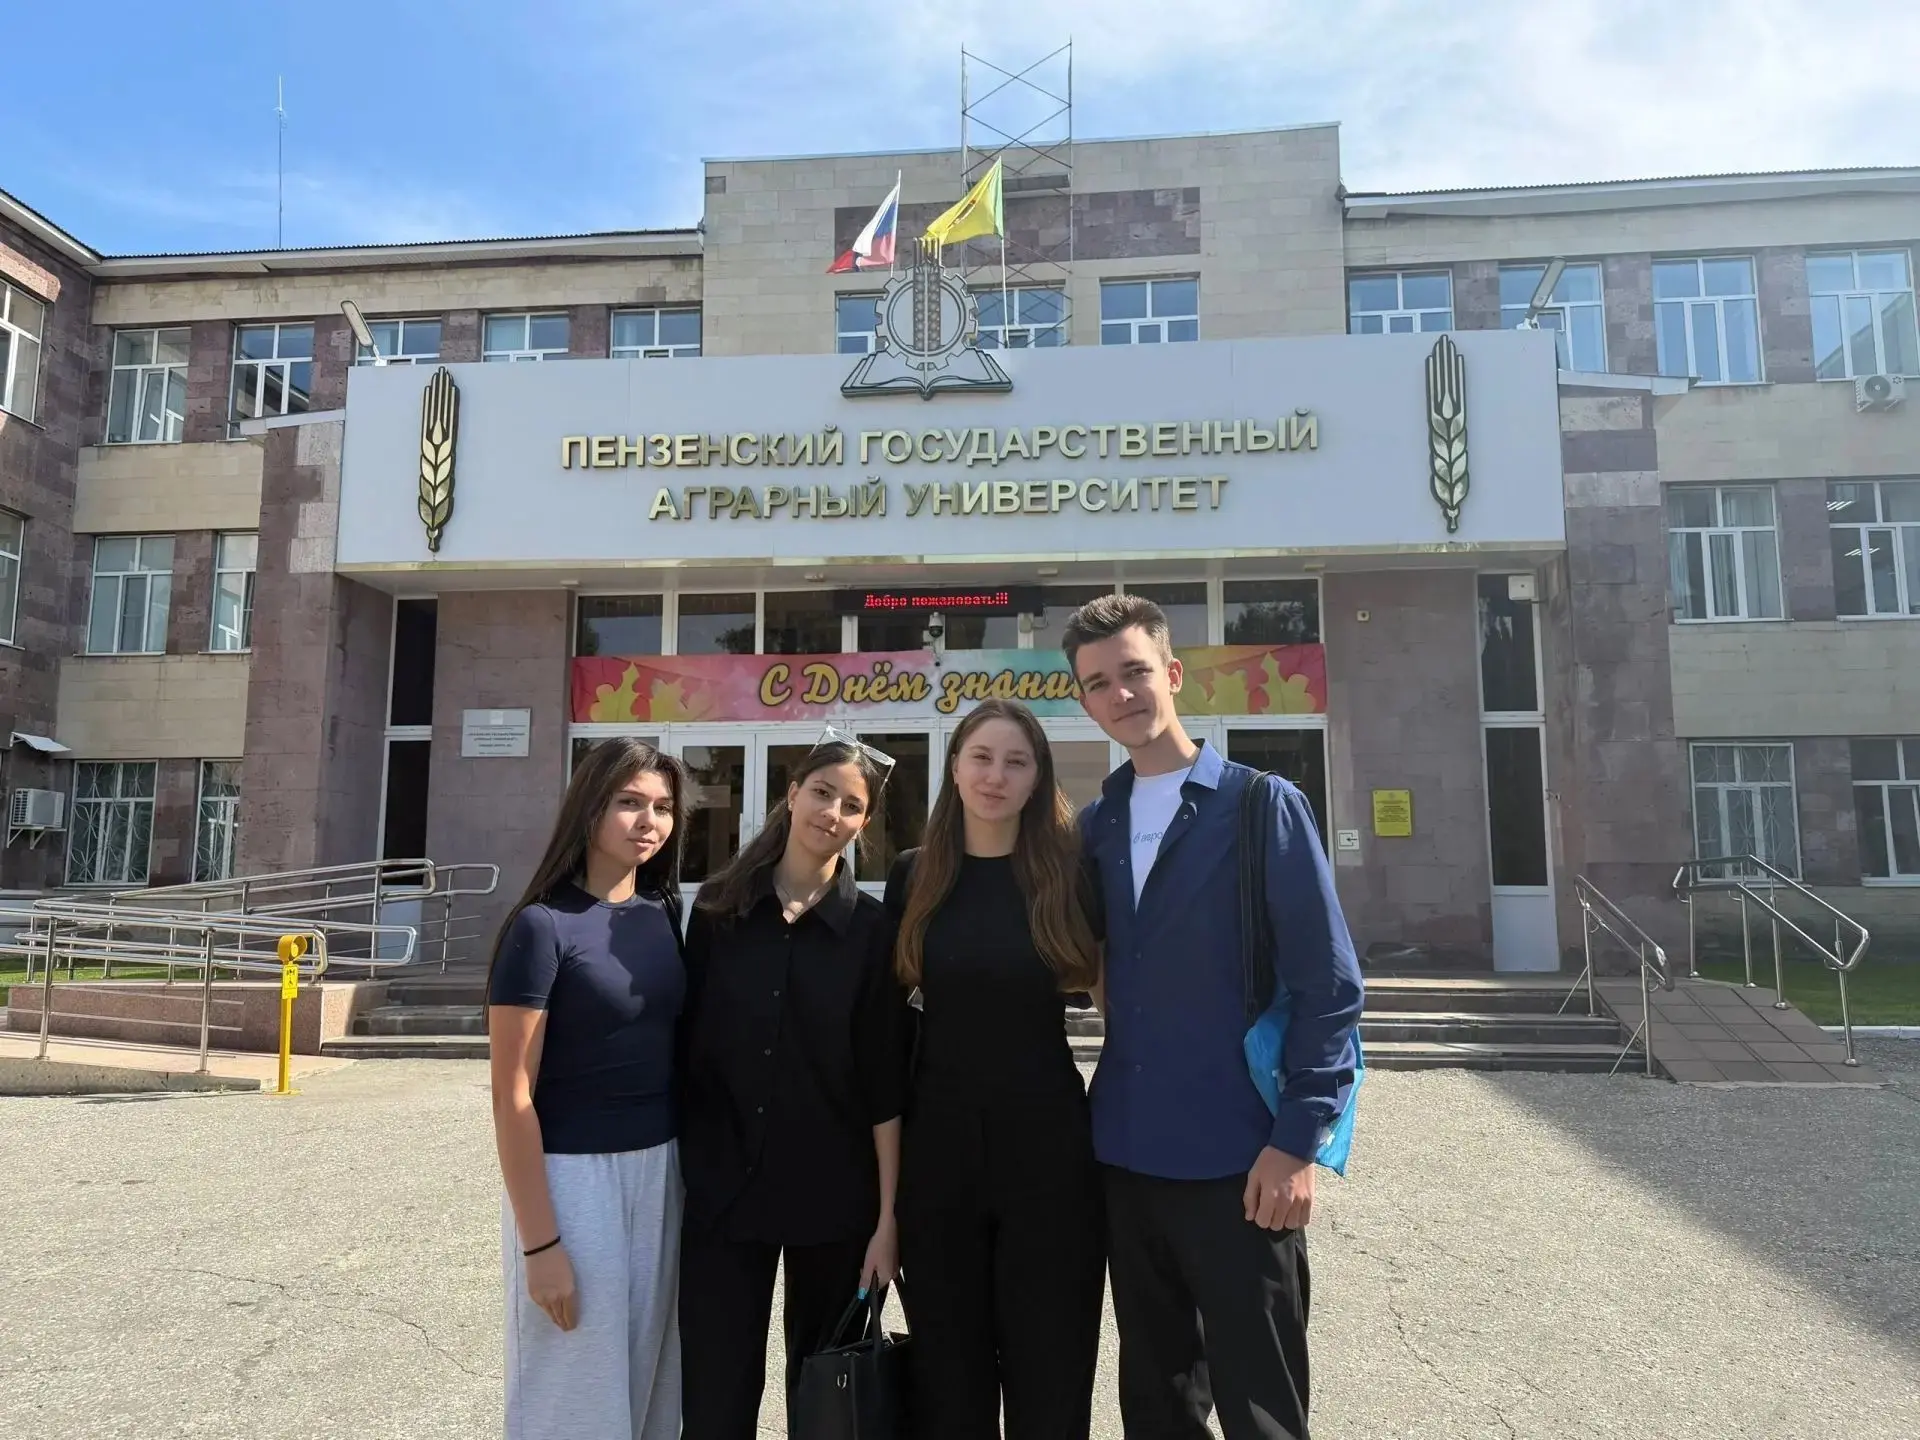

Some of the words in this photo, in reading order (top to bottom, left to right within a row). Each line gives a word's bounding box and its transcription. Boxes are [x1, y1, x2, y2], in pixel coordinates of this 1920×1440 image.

[561, 424, 844, 468] ПЕНЗЕНСКИЙ
[859, 408, 1319, 467] ГОСУДАРСТВЕННЫЙ
[648, 476, 887, 520] АГРАРНЫЙ
[905, 475, 1229, 517] УНИВЕРСИТЕТ
[864, 594, 907, 609] Добро
[911, 592, 1008, 607] пожаловать!!!
[760, 662, 792, 706] С
[802, 660, 932, 705] Днём
